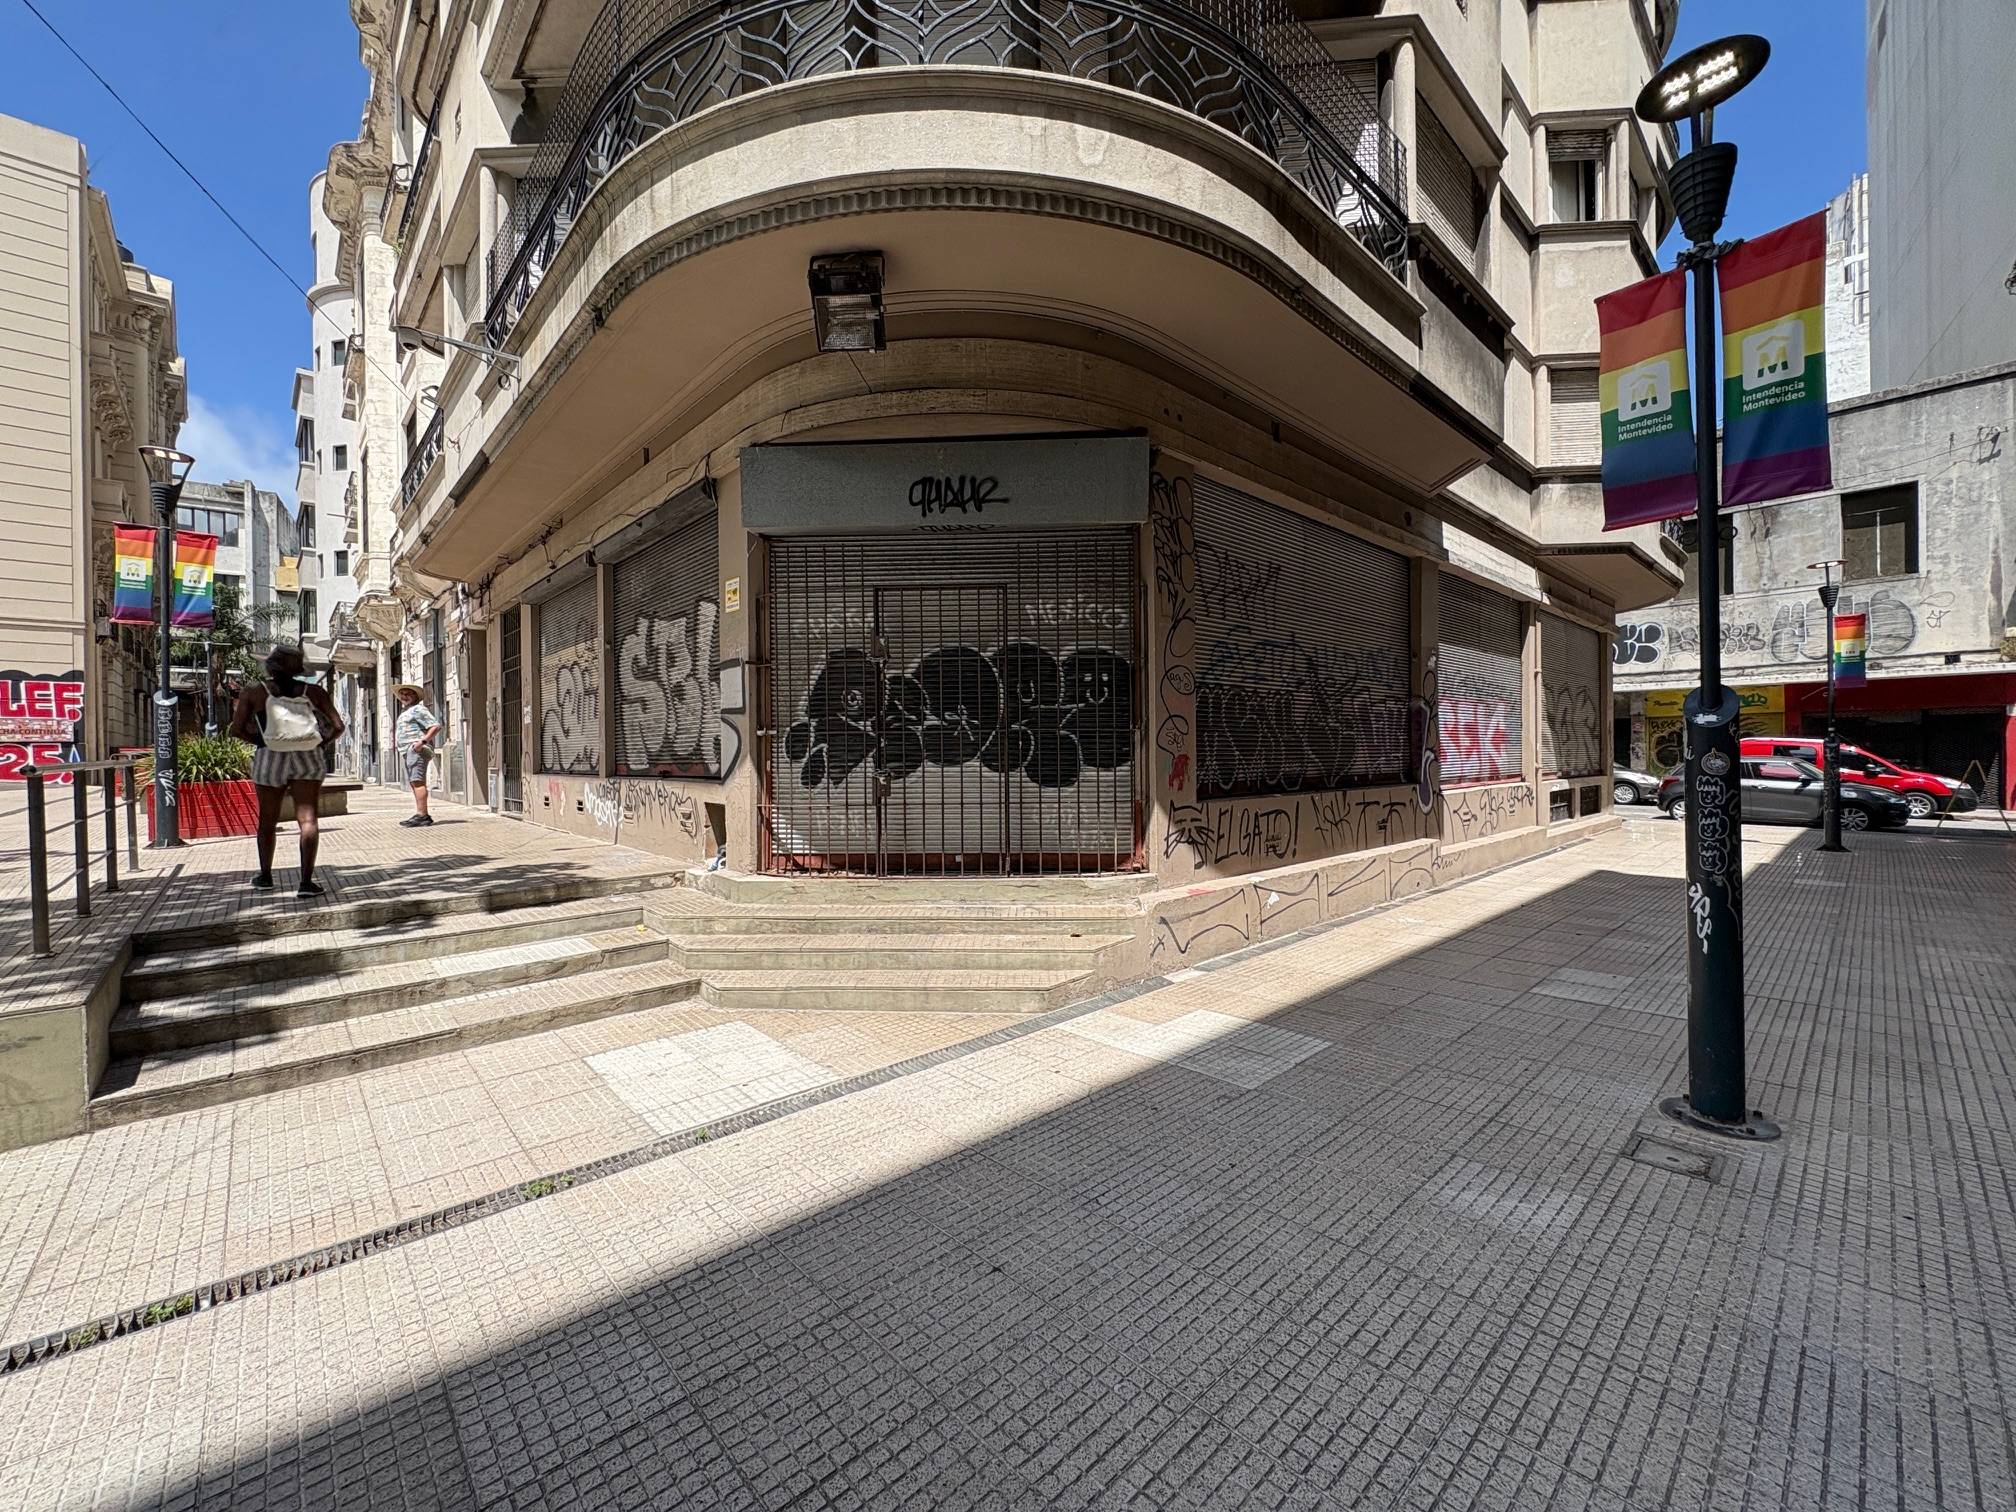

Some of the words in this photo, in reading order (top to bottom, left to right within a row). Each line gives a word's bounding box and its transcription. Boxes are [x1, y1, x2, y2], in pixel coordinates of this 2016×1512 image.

[1742, 381, 1805, 404] Intendencia
[1742, 390, 1806, 413] Montevideo
[1617, 413, 1673, 433] Intendencia
[1617, 422, 1674, 441] Montevideo
